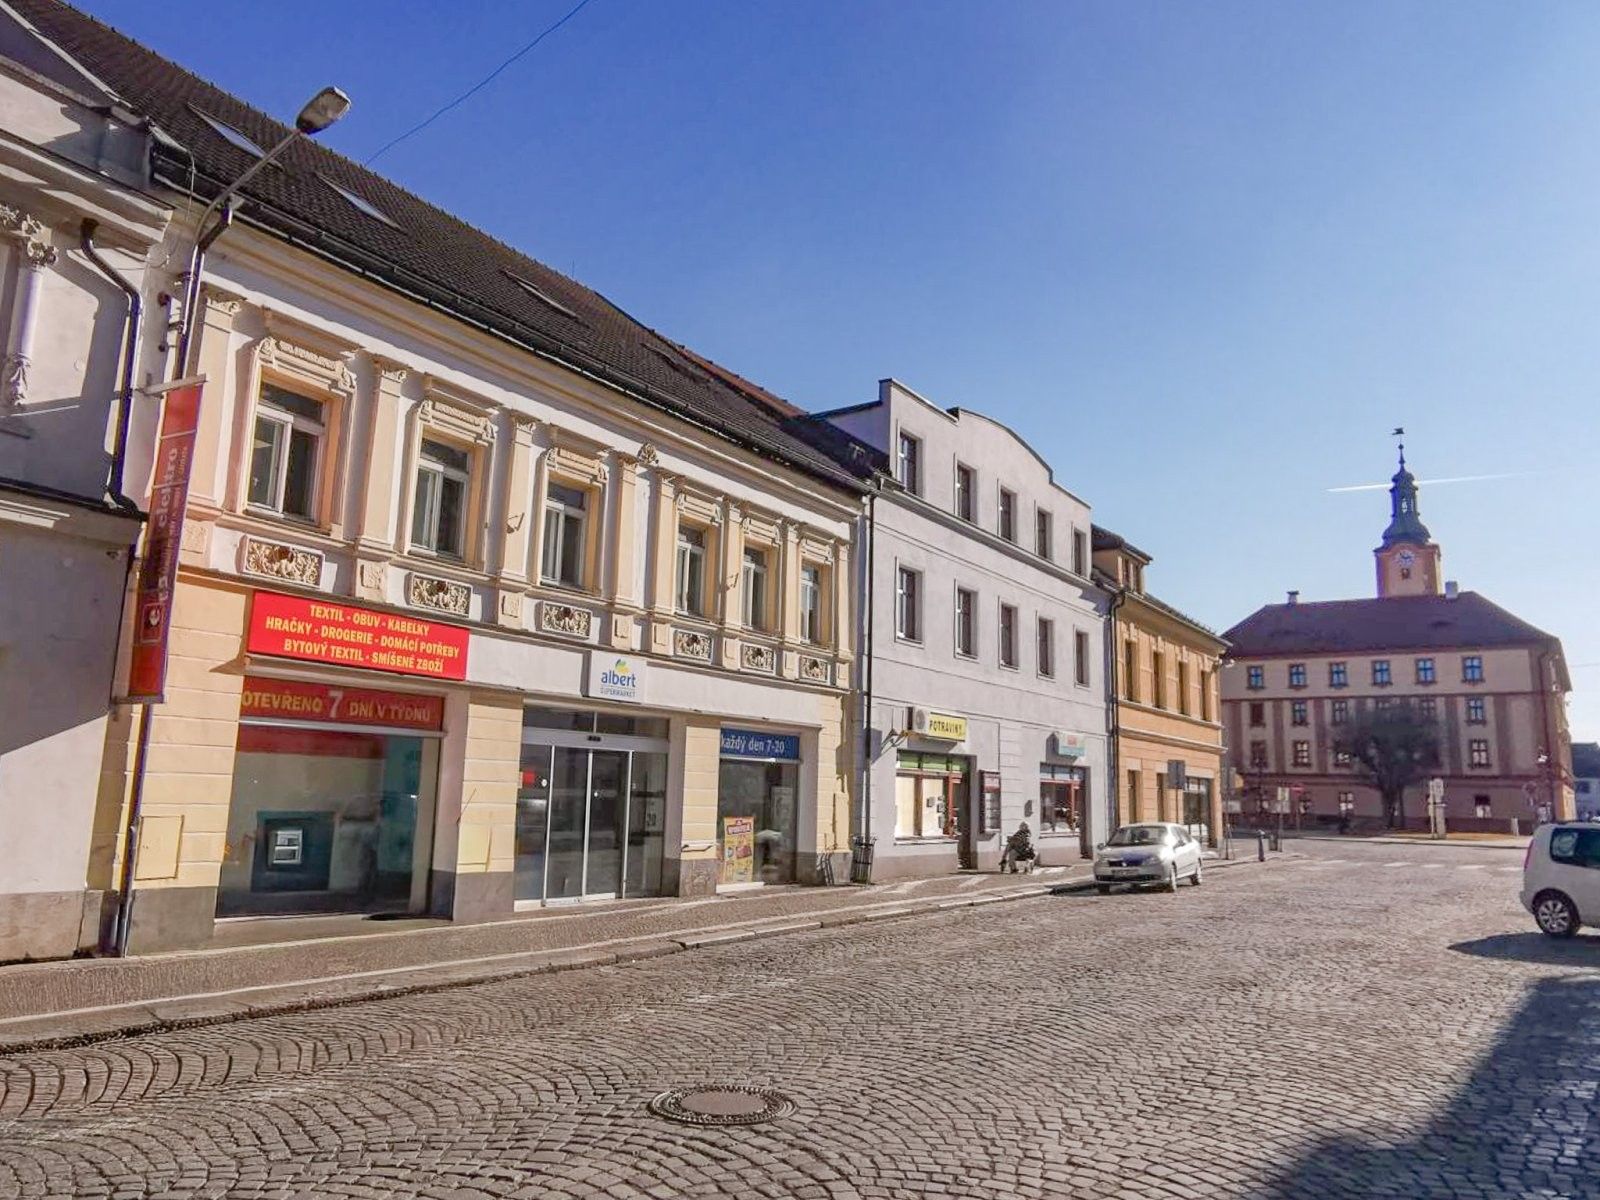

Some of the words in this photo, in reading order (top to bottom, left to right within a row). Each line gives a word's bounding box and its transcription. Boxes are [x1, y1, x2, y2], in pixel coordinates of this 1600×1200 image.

[310, 604, 344, 622] TEXTIL
[352, 612, 380, 628] OBUV
[387, 618, 430, 637] KABELKY
[265, 615, 313, 636] HRAČKY
[321, 624, 374, 645] DROGERIE
[380, 635, 418, 652] DOMÁCÍ
[420, 641, 460, 659] POTŘEBY
[284, 638, 328, 657] BYTOVÝ
[330, 645, 364, 661] TEXTIL
[372, 651, 415, 669] SMÍŠENÉ
[416, 658, 445, 673] ZBOŽÍ
[601, 669, 636, 688] albert
[241, 690, 323, 713] OTEVŘENO
[328, 690, 344, 718] 7
[350, 699, 375, 718] DNÍ
[377, 703, 387, 719] V
[748, 736, 764, 751] den
[766, 739, 785, 754] 7-20
